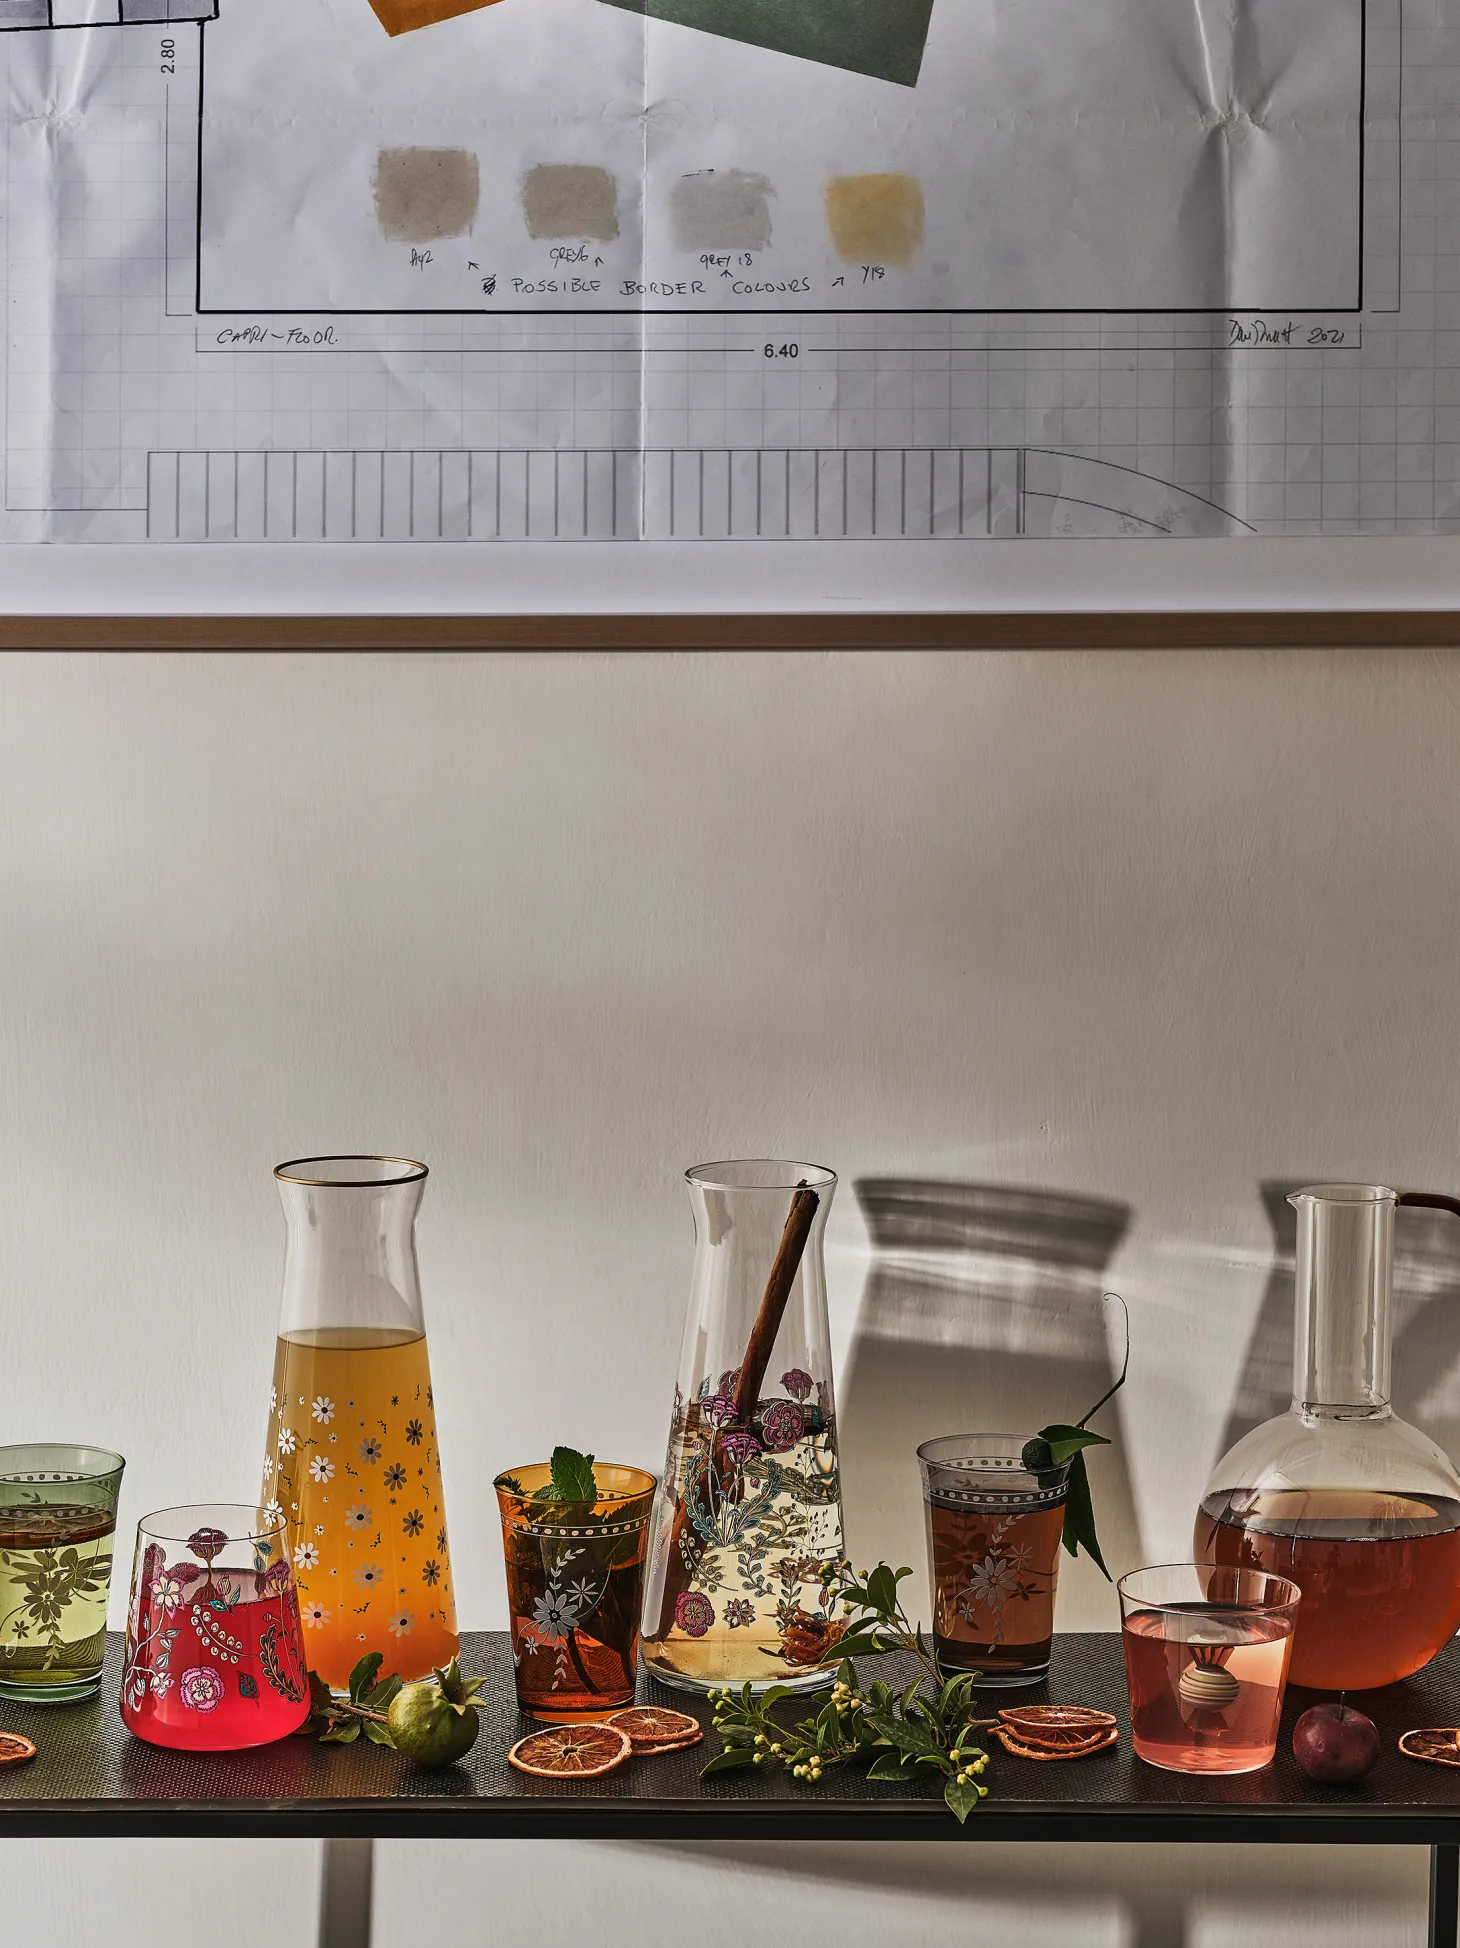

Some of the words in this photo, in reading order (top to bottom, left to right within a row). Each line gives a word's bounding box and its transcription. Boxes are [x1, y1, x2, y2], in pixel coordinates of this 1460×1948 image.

[160, 38, 175, 74] 2.80
[511, 277, 601, 294] POSSIBLE
[619, 280, 706, 297] BORDER
[732, 277, 811, 295] COLOURS
[1307, 327, 1345, 344] 2021
[764, 343, 799, 359] 6.40
